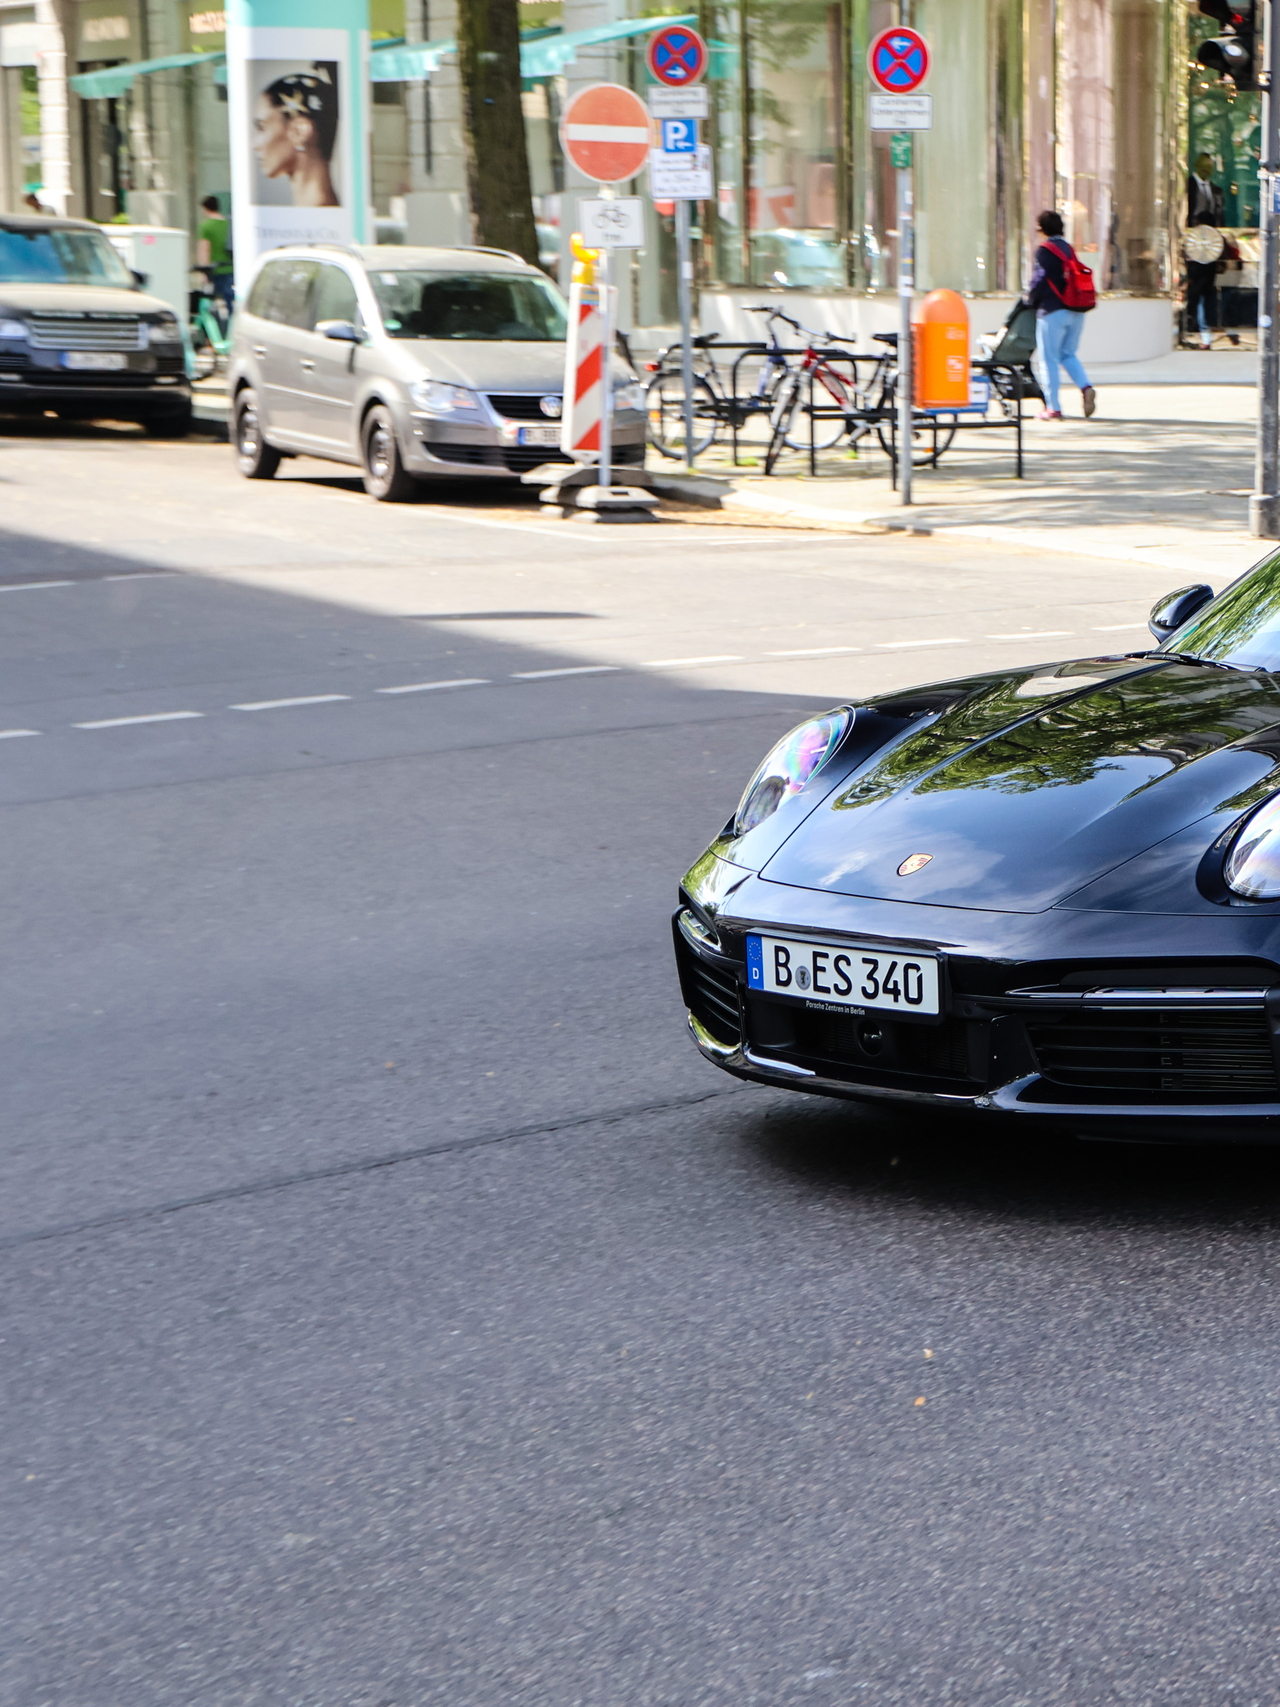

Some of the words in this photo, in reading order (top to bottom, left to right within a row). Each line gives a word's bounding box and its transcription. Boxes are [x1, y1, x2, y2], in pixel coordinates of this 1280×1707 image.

[665, 121, 688, 150] P
[752, 967, 760, 980] D
[774, 945, 792, 987] B
[812, 951, 853, 996] ES
[861, 957, 924, 1005] 340
[805, 1000, 824, 1011] Porsche
[825, 1003, 844, 1013] Zentren
[844, 1005, 850, 1013] in
[850, 1006, 865, 1016] Berlin
